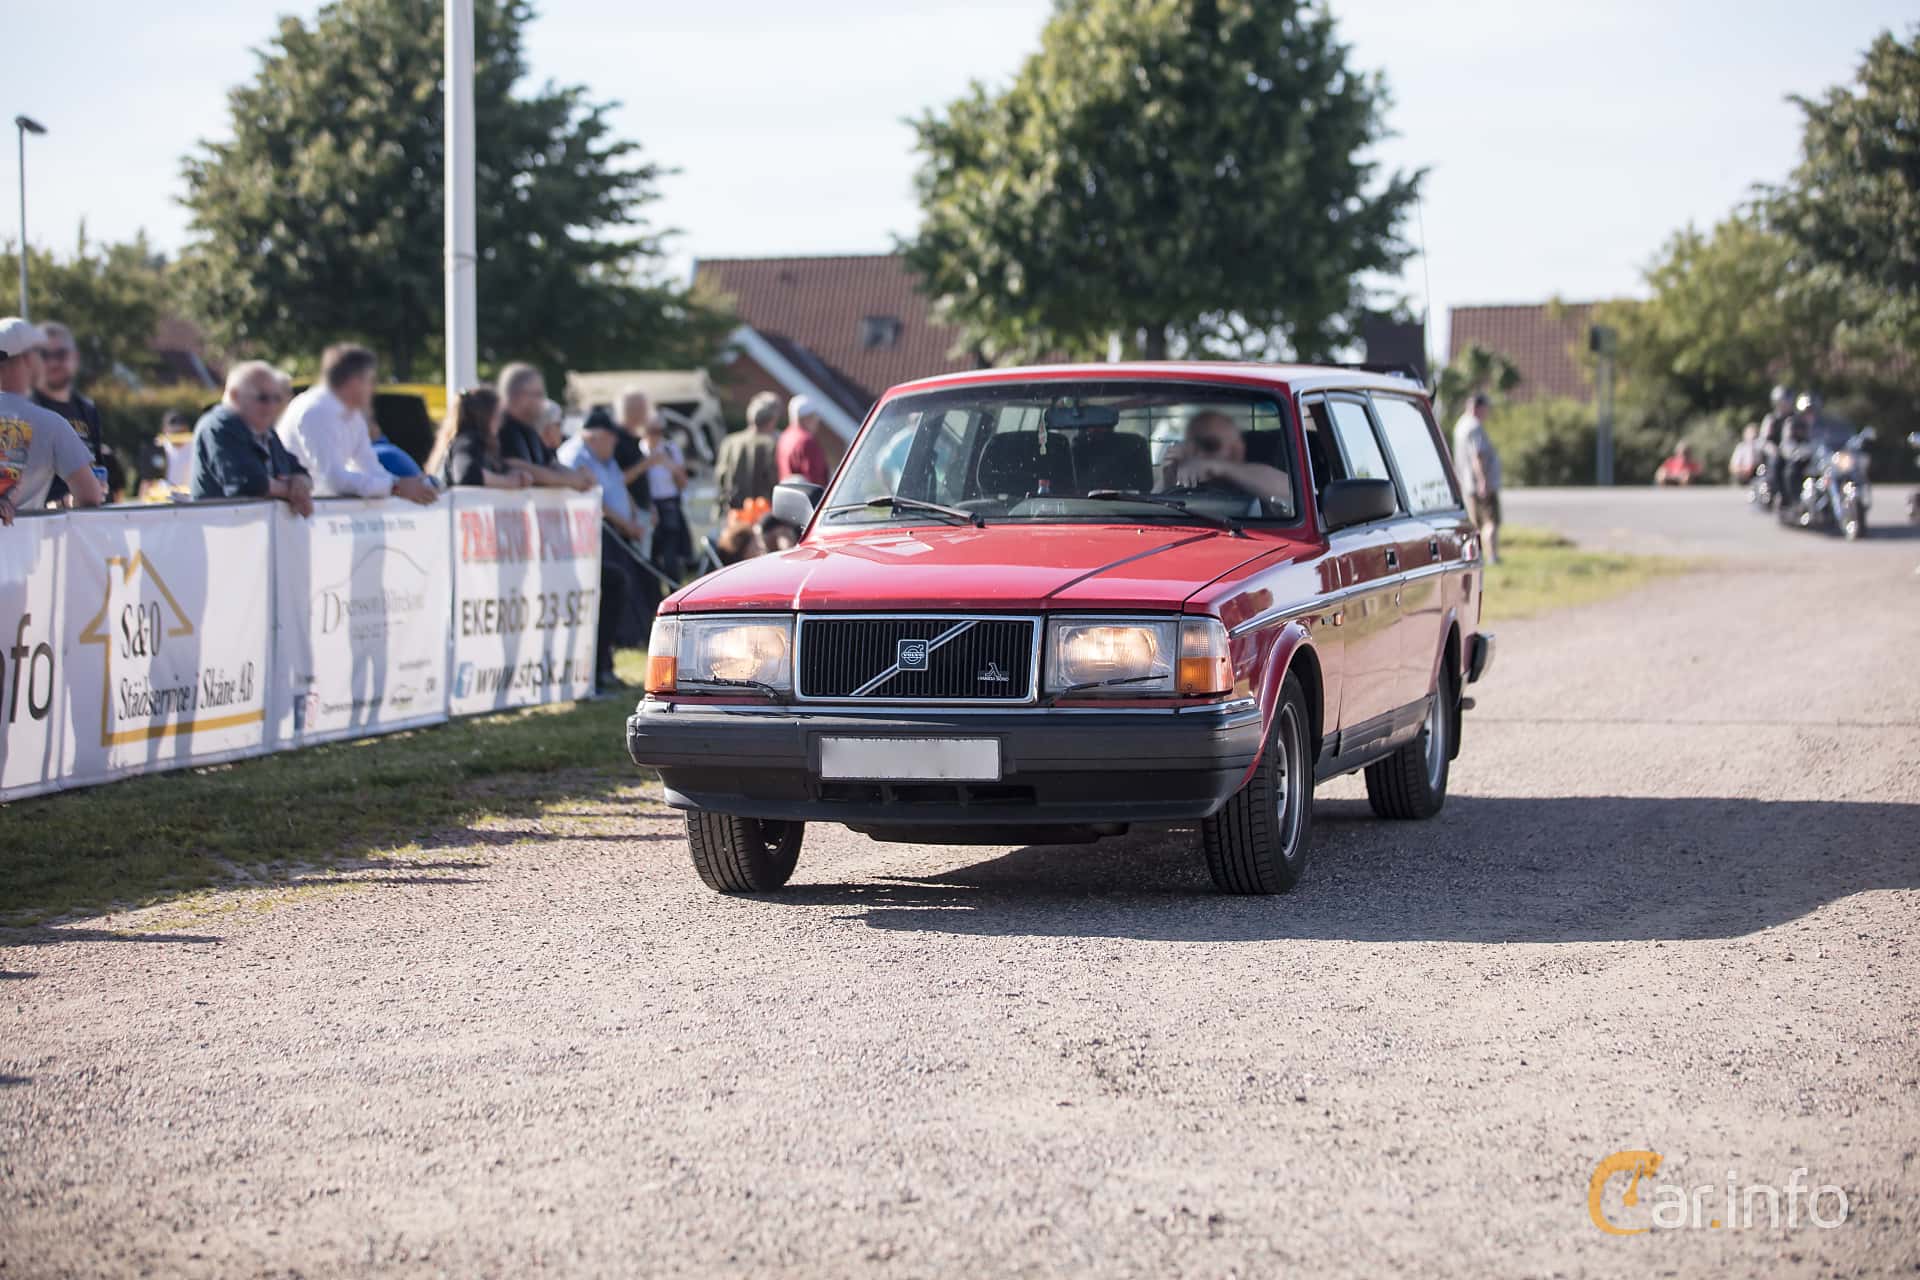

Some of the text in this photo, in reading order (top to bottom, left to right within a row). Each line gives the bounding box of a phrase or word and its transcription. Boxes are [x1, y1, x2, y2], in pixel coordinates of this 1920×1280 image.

[121, 600, 162, 658] S&O
[462, 588, 528, 637] EKERÖD
[535, 593, 559, 631] 23
[119, 673, 190, 720] Städservice
[200, 666, 236, 709] Skåne
[238, 661, 256, 703] AB
